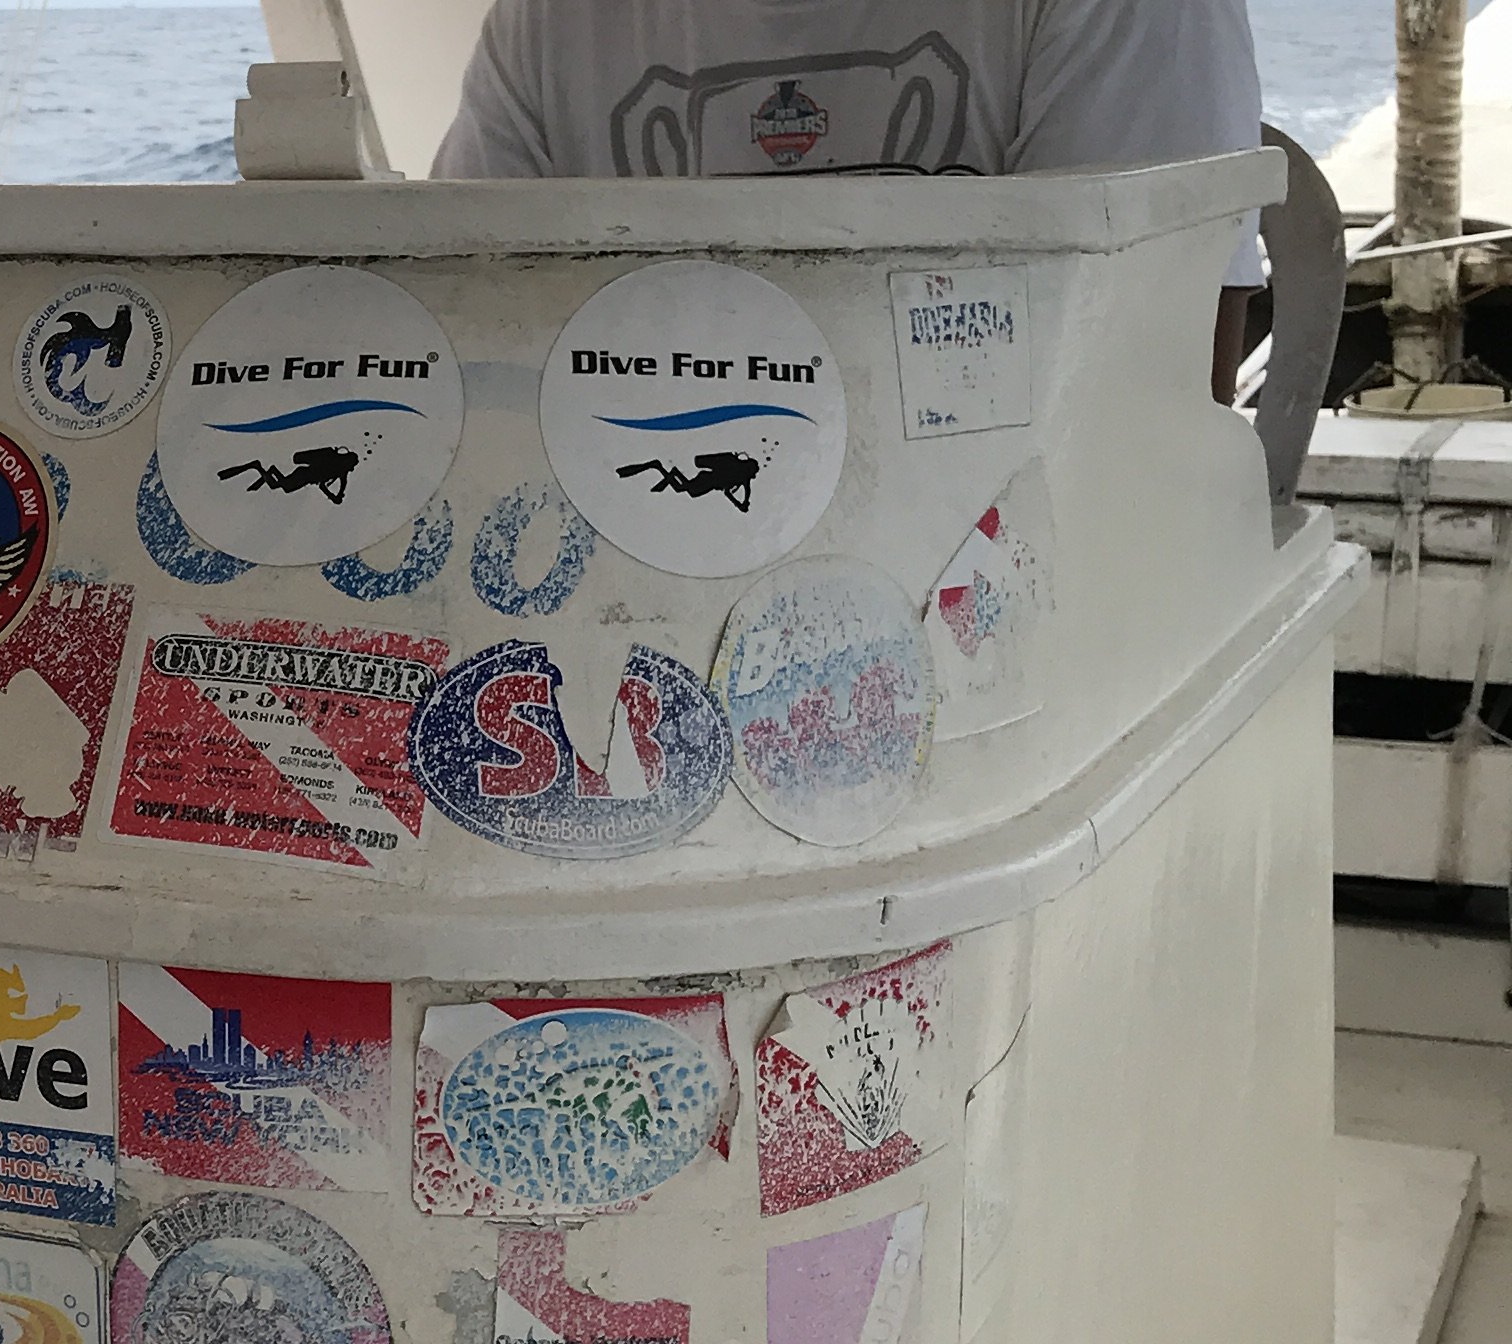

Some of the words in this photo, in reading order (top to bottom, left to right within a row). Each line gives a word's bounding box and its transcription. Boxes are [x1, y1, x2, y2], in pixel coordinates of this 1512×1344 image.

[191, 362, 270, 386] Dive
[283, 357, 344, 381] For
[570, 350, 657, 376] Dive
[671, 352, 734, 380] For
[163, 641, 426, 700] UNDERWATER
[7, 1132, 50, 1156] 360
